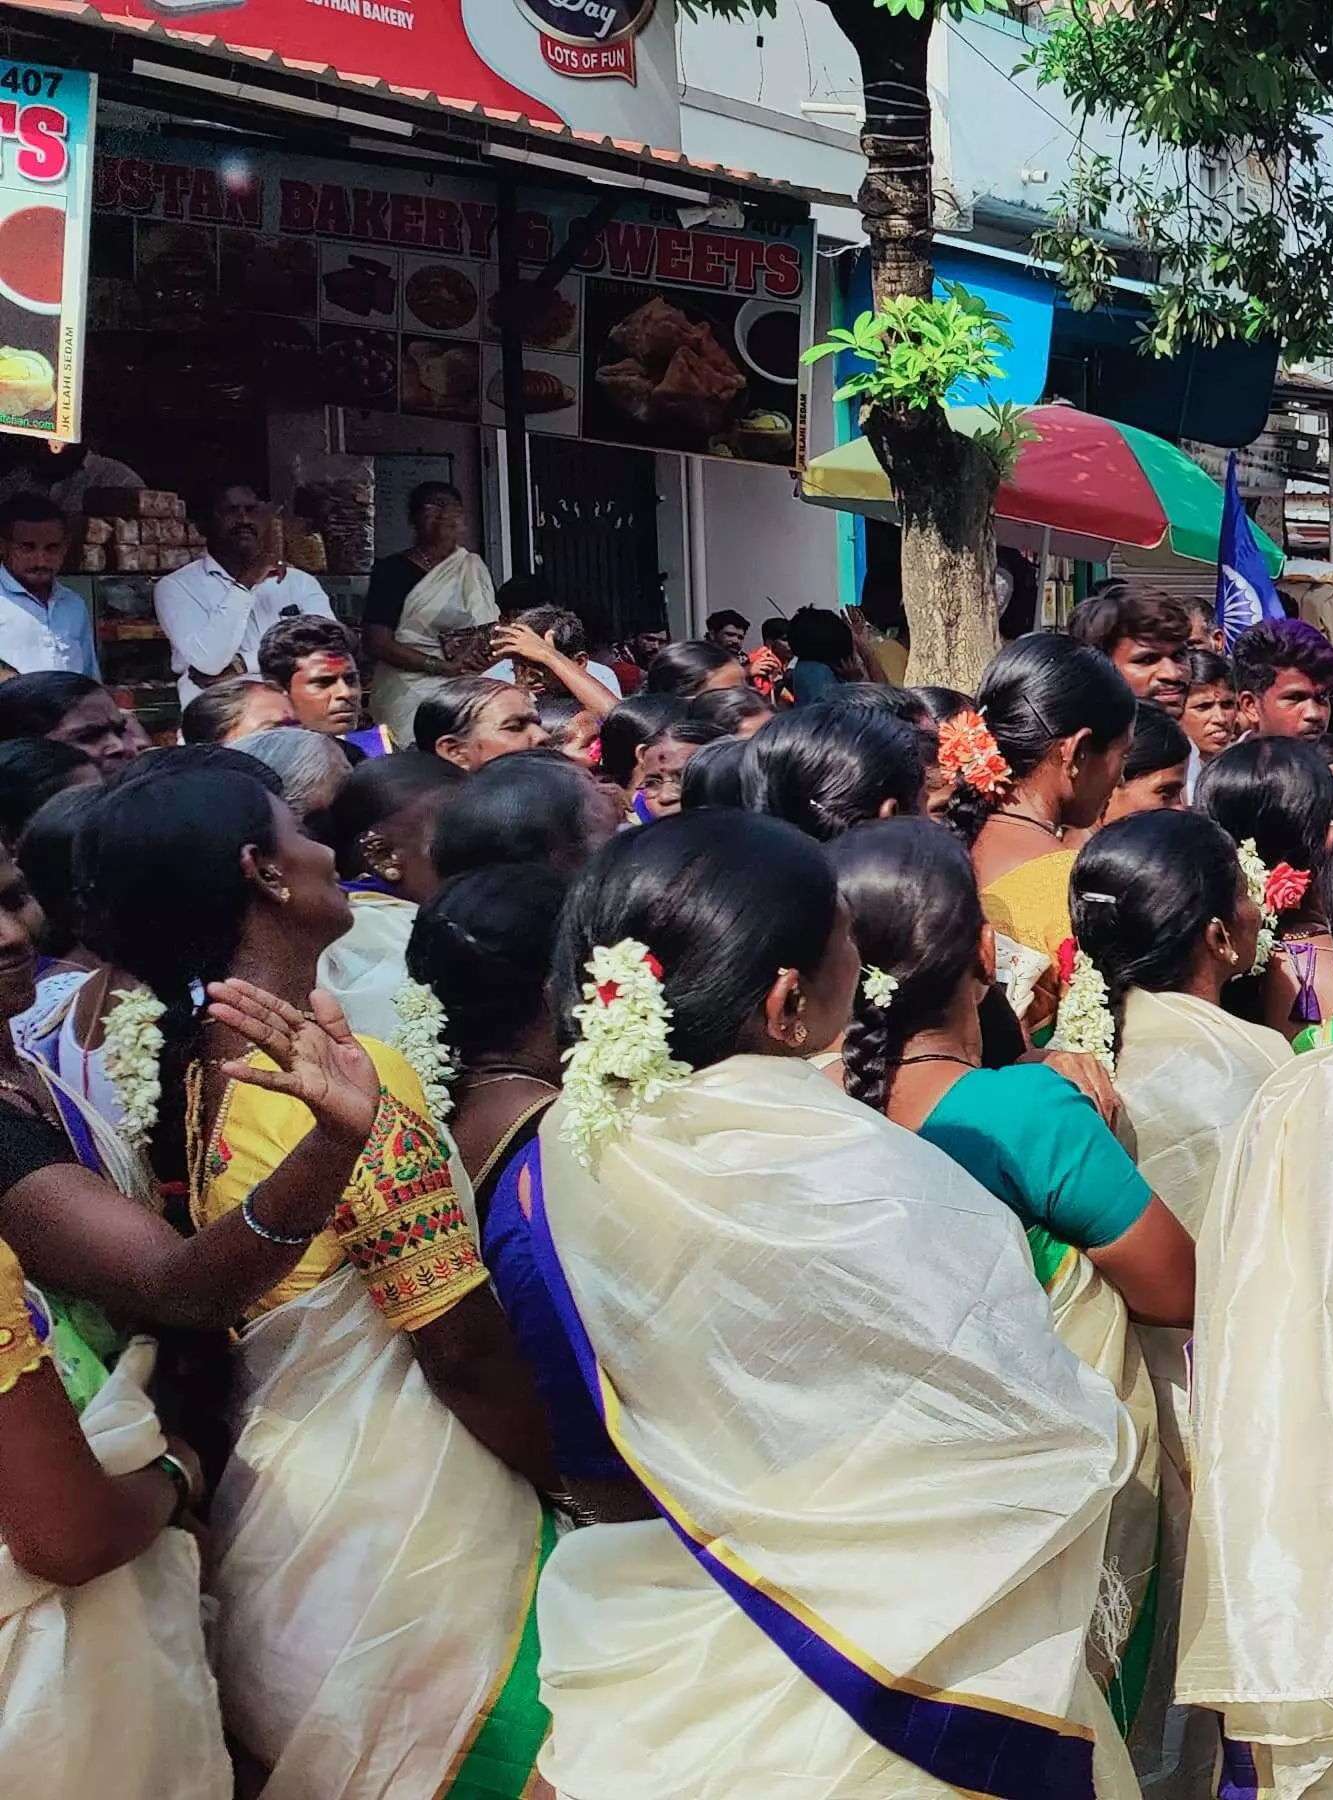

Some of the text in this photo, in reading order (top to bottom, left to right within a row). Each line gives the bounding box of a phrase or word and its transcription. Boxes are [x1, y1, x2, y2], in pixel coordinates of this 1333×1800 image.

[362, 1, 414, 30] BAKERY
[547, 41, 625, 69] LOTS OF FUN
[279, 178, 500, 260] BAKERY
[569, 215, 803, 299] SWEETS
